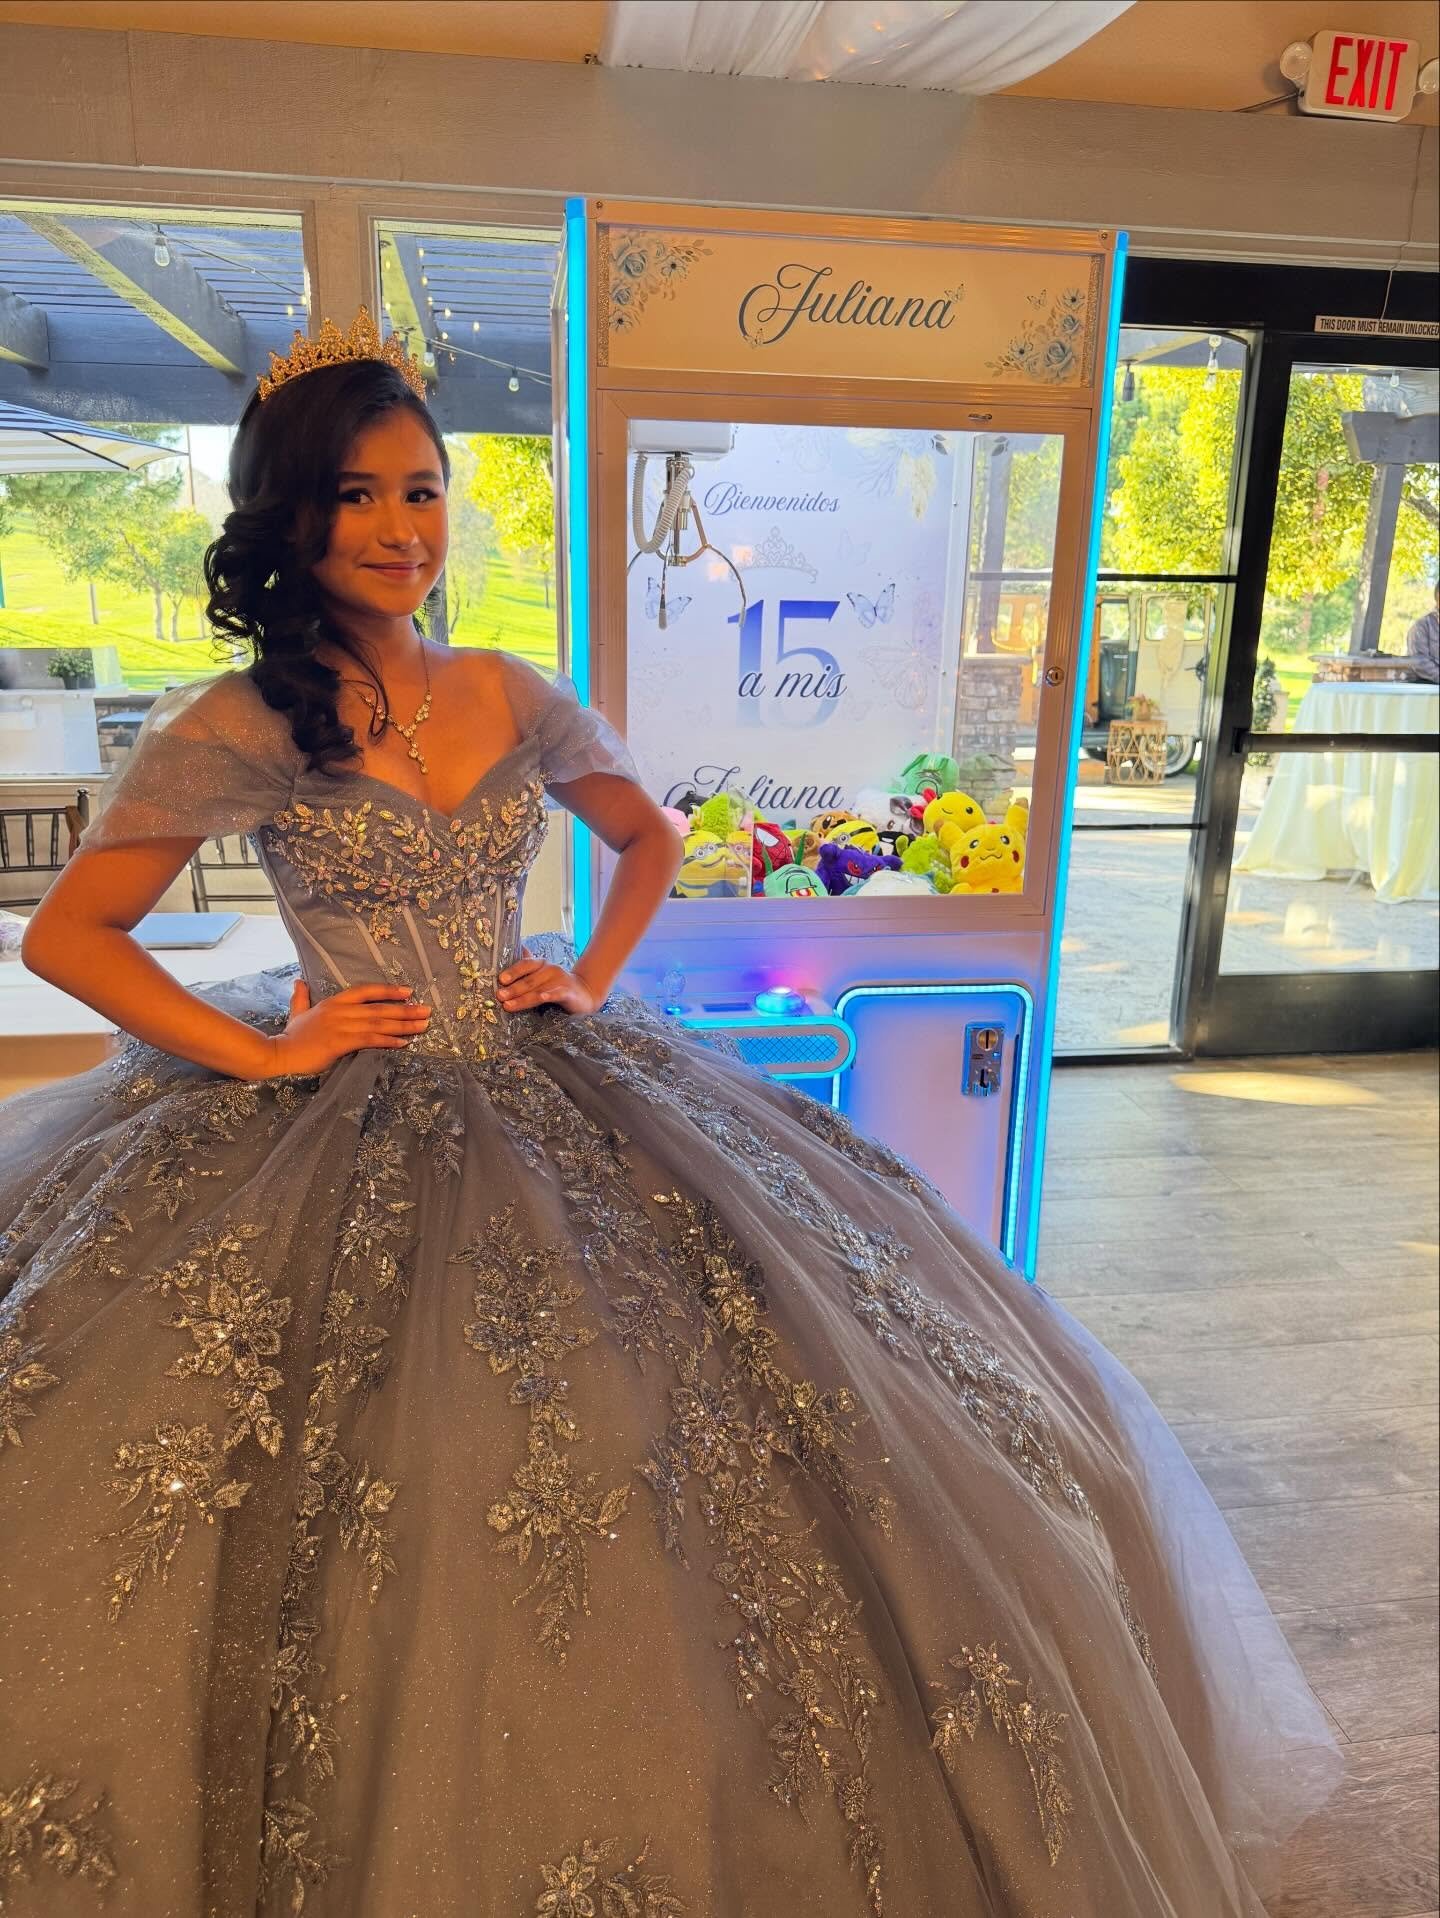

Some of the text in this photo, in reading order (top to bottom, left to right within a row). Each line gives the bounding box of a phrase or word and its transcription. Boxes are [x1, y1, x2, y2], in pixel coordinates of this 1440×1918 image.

[1325, 36, 1408, 111] EXIT
[738, 263, 955, 345] Juliana
[1320, 319, 1439, 335] THIS DOOR MUST REMAIN UNLOCKED
[704, 481, 840, 516] Bienvenidos
[727, 599, 842, 733] 15
[738, 664, 847, 698] a mis
[663, 765, 844, 809] Jliana
